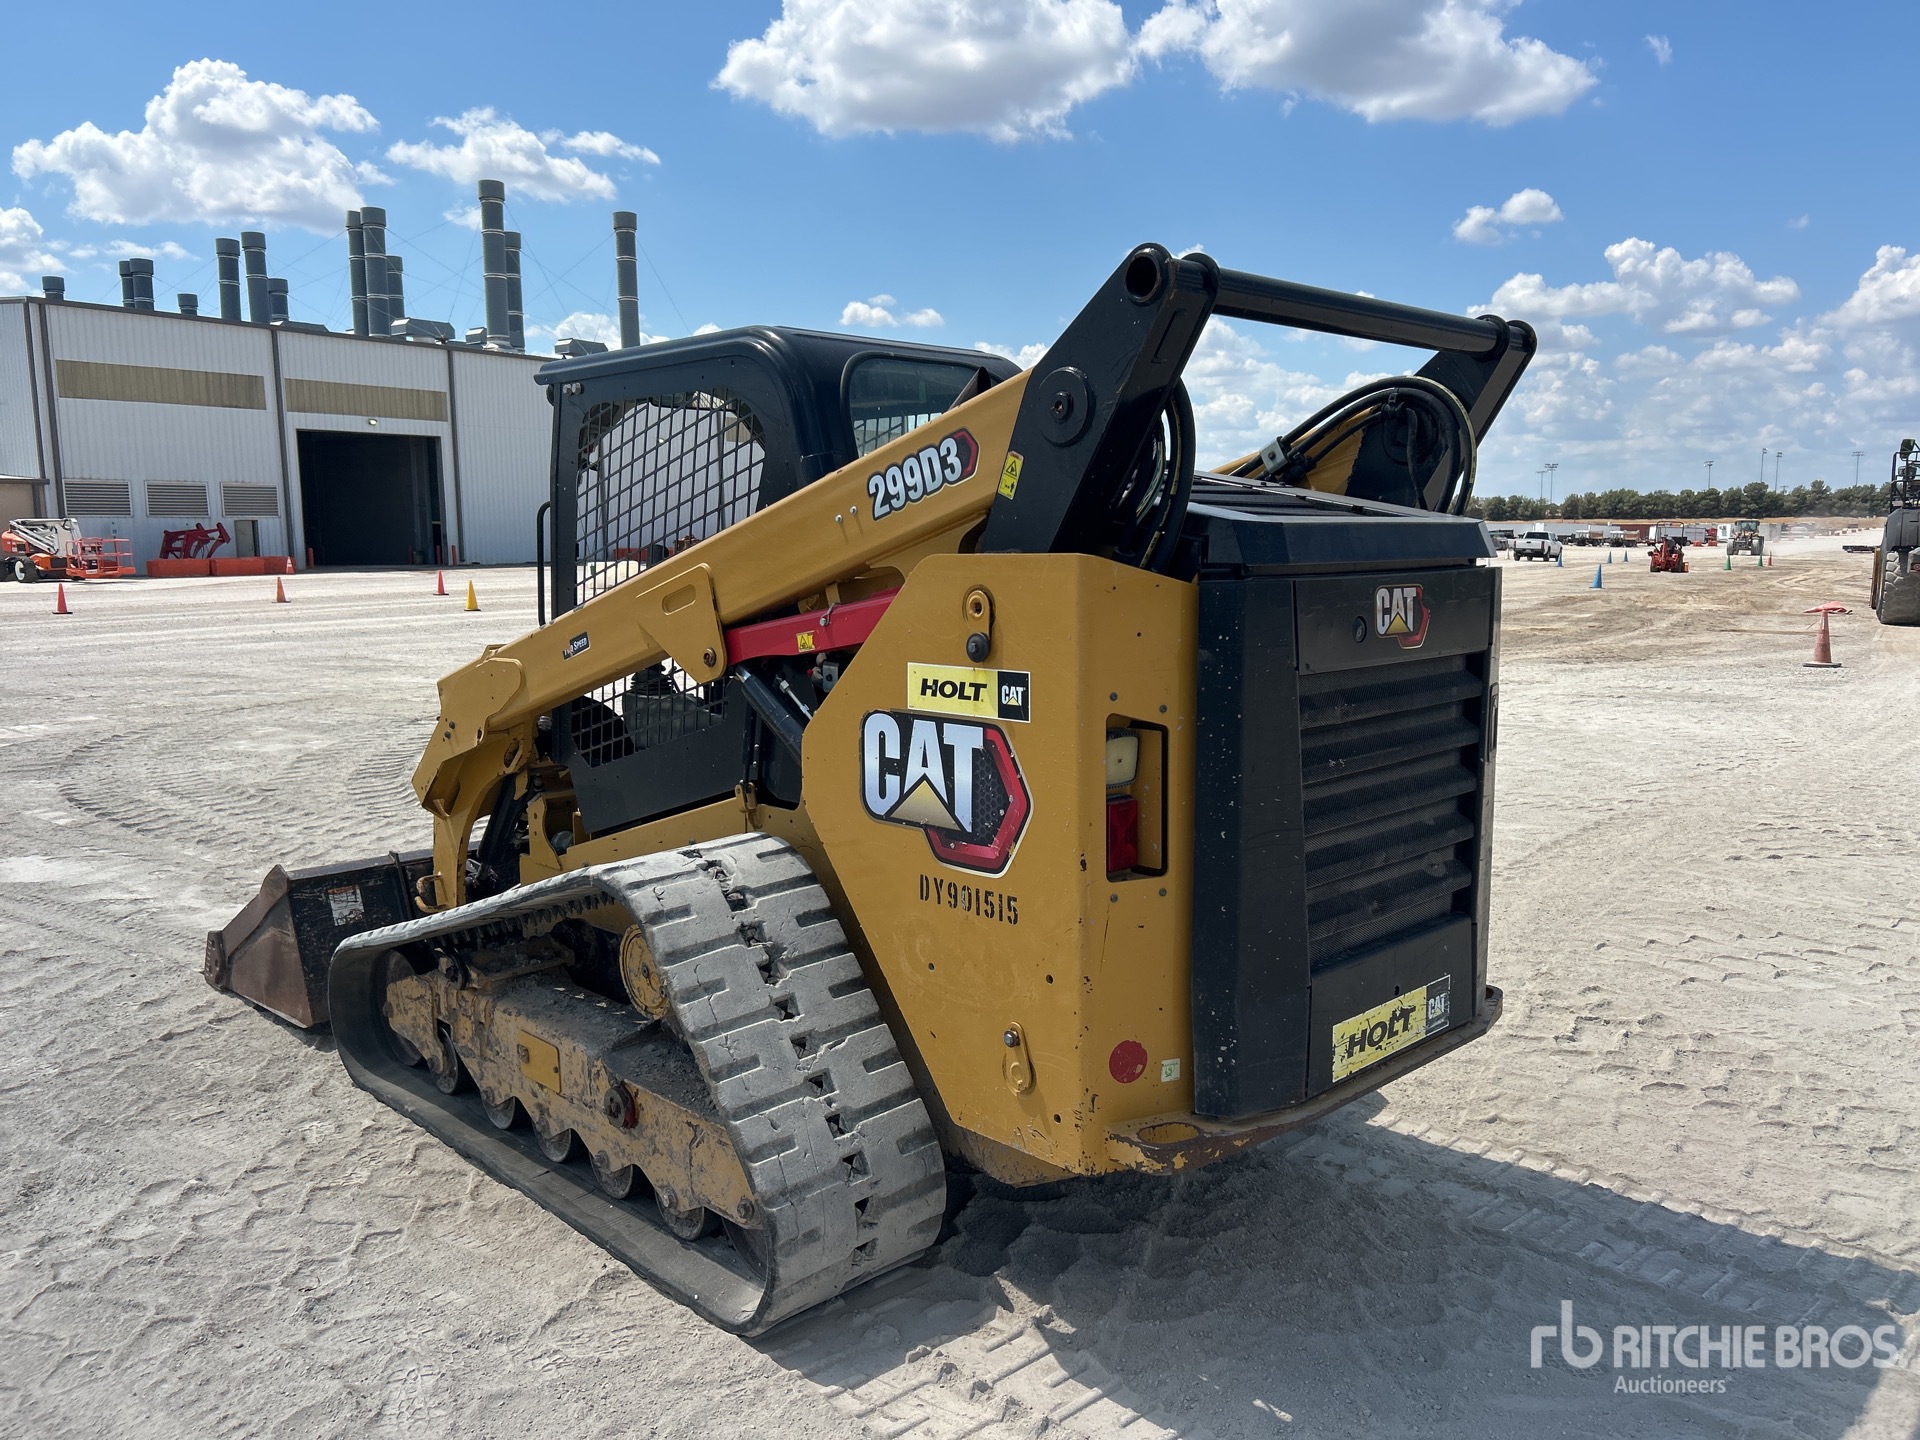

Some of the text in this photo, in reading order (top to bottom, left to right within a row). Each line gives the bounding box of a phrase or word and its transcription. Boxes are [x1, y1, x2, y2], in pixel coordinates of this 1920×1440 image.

[868, 437, 963, 519] 299D3
[1376, 587, 1417, 635] CAT
[920, 678, 1025, 706] HOLT CAT
[864, 712, 984, 833] CAT
[919, 873, 1019, 925] DY901515
[1346, 992, 1447, 1060] HOLT CAT
